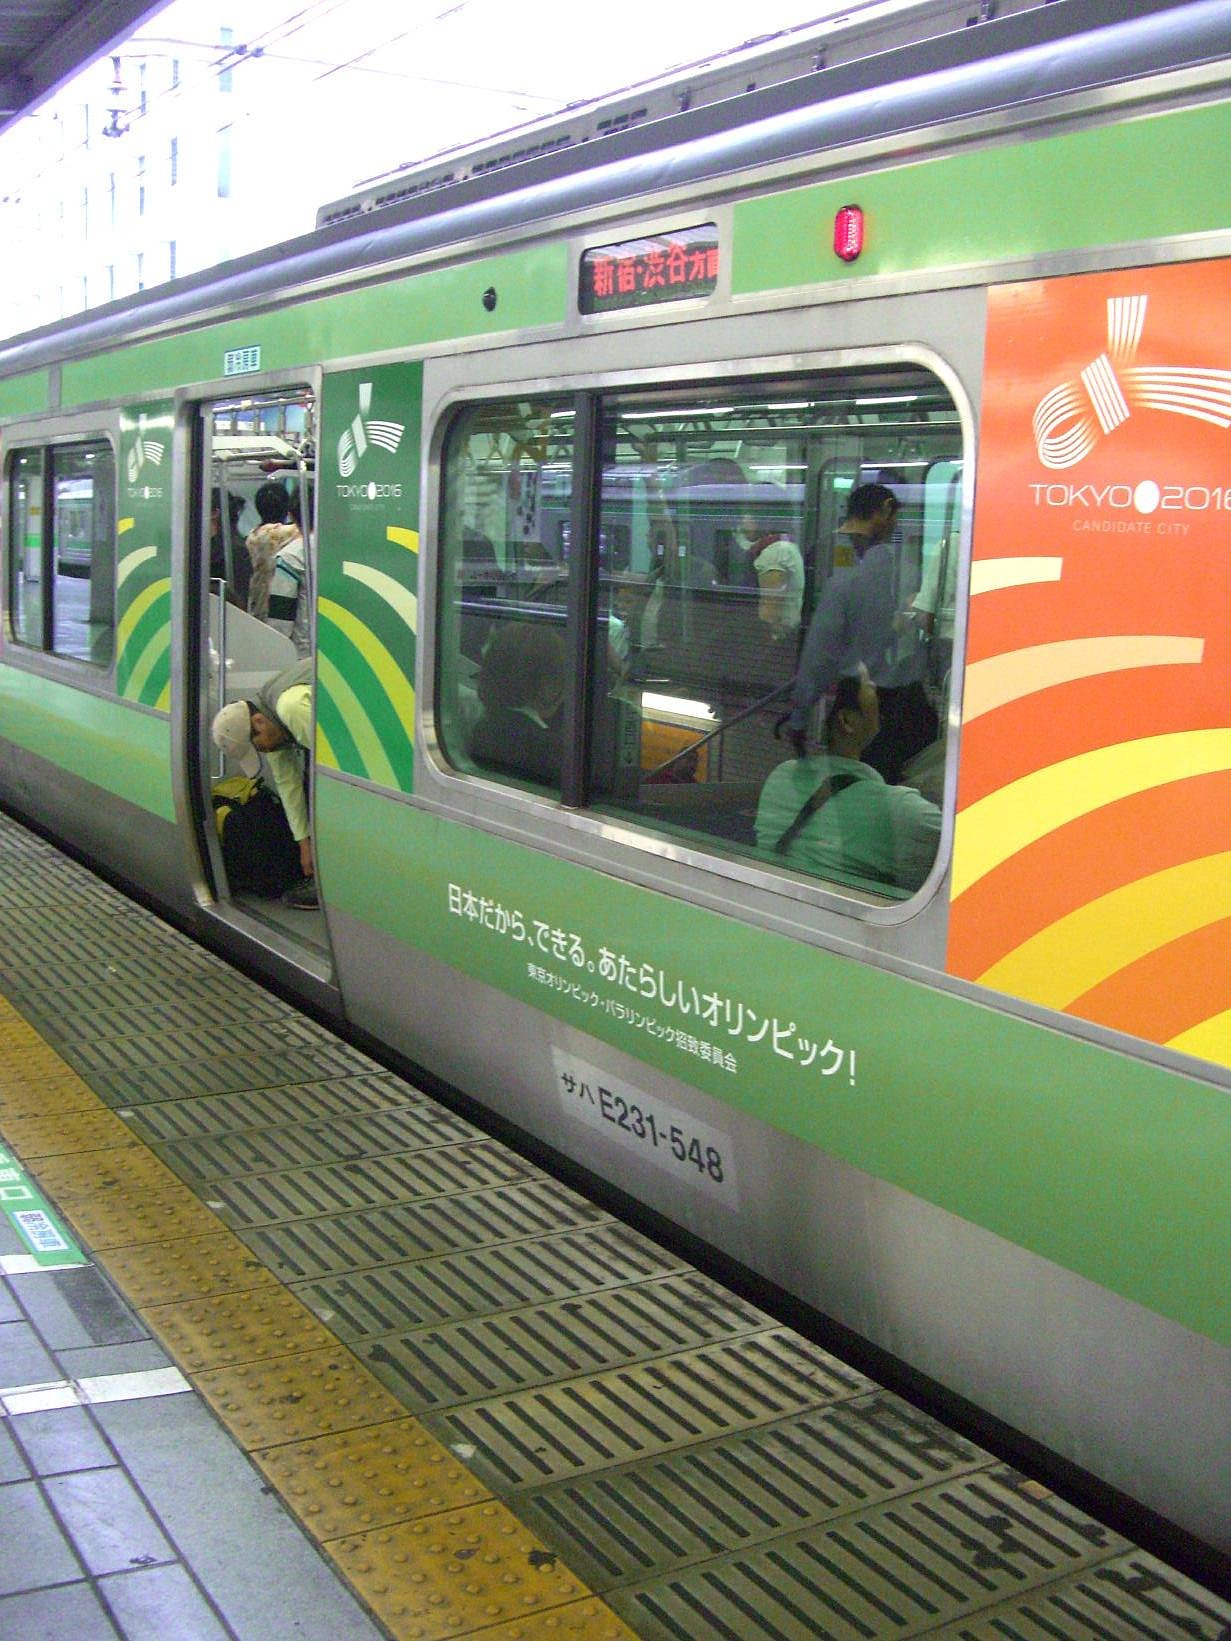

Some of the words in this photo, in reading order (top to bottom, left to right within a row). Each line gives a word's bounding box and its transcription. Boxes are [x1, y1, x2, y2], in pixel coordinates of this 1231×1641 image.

[1029, 484, 1132, 508] TOKYO
[1072, 519, 1151, 534] CANDIDATE
[1157, 523, 1190, 536] CITY
